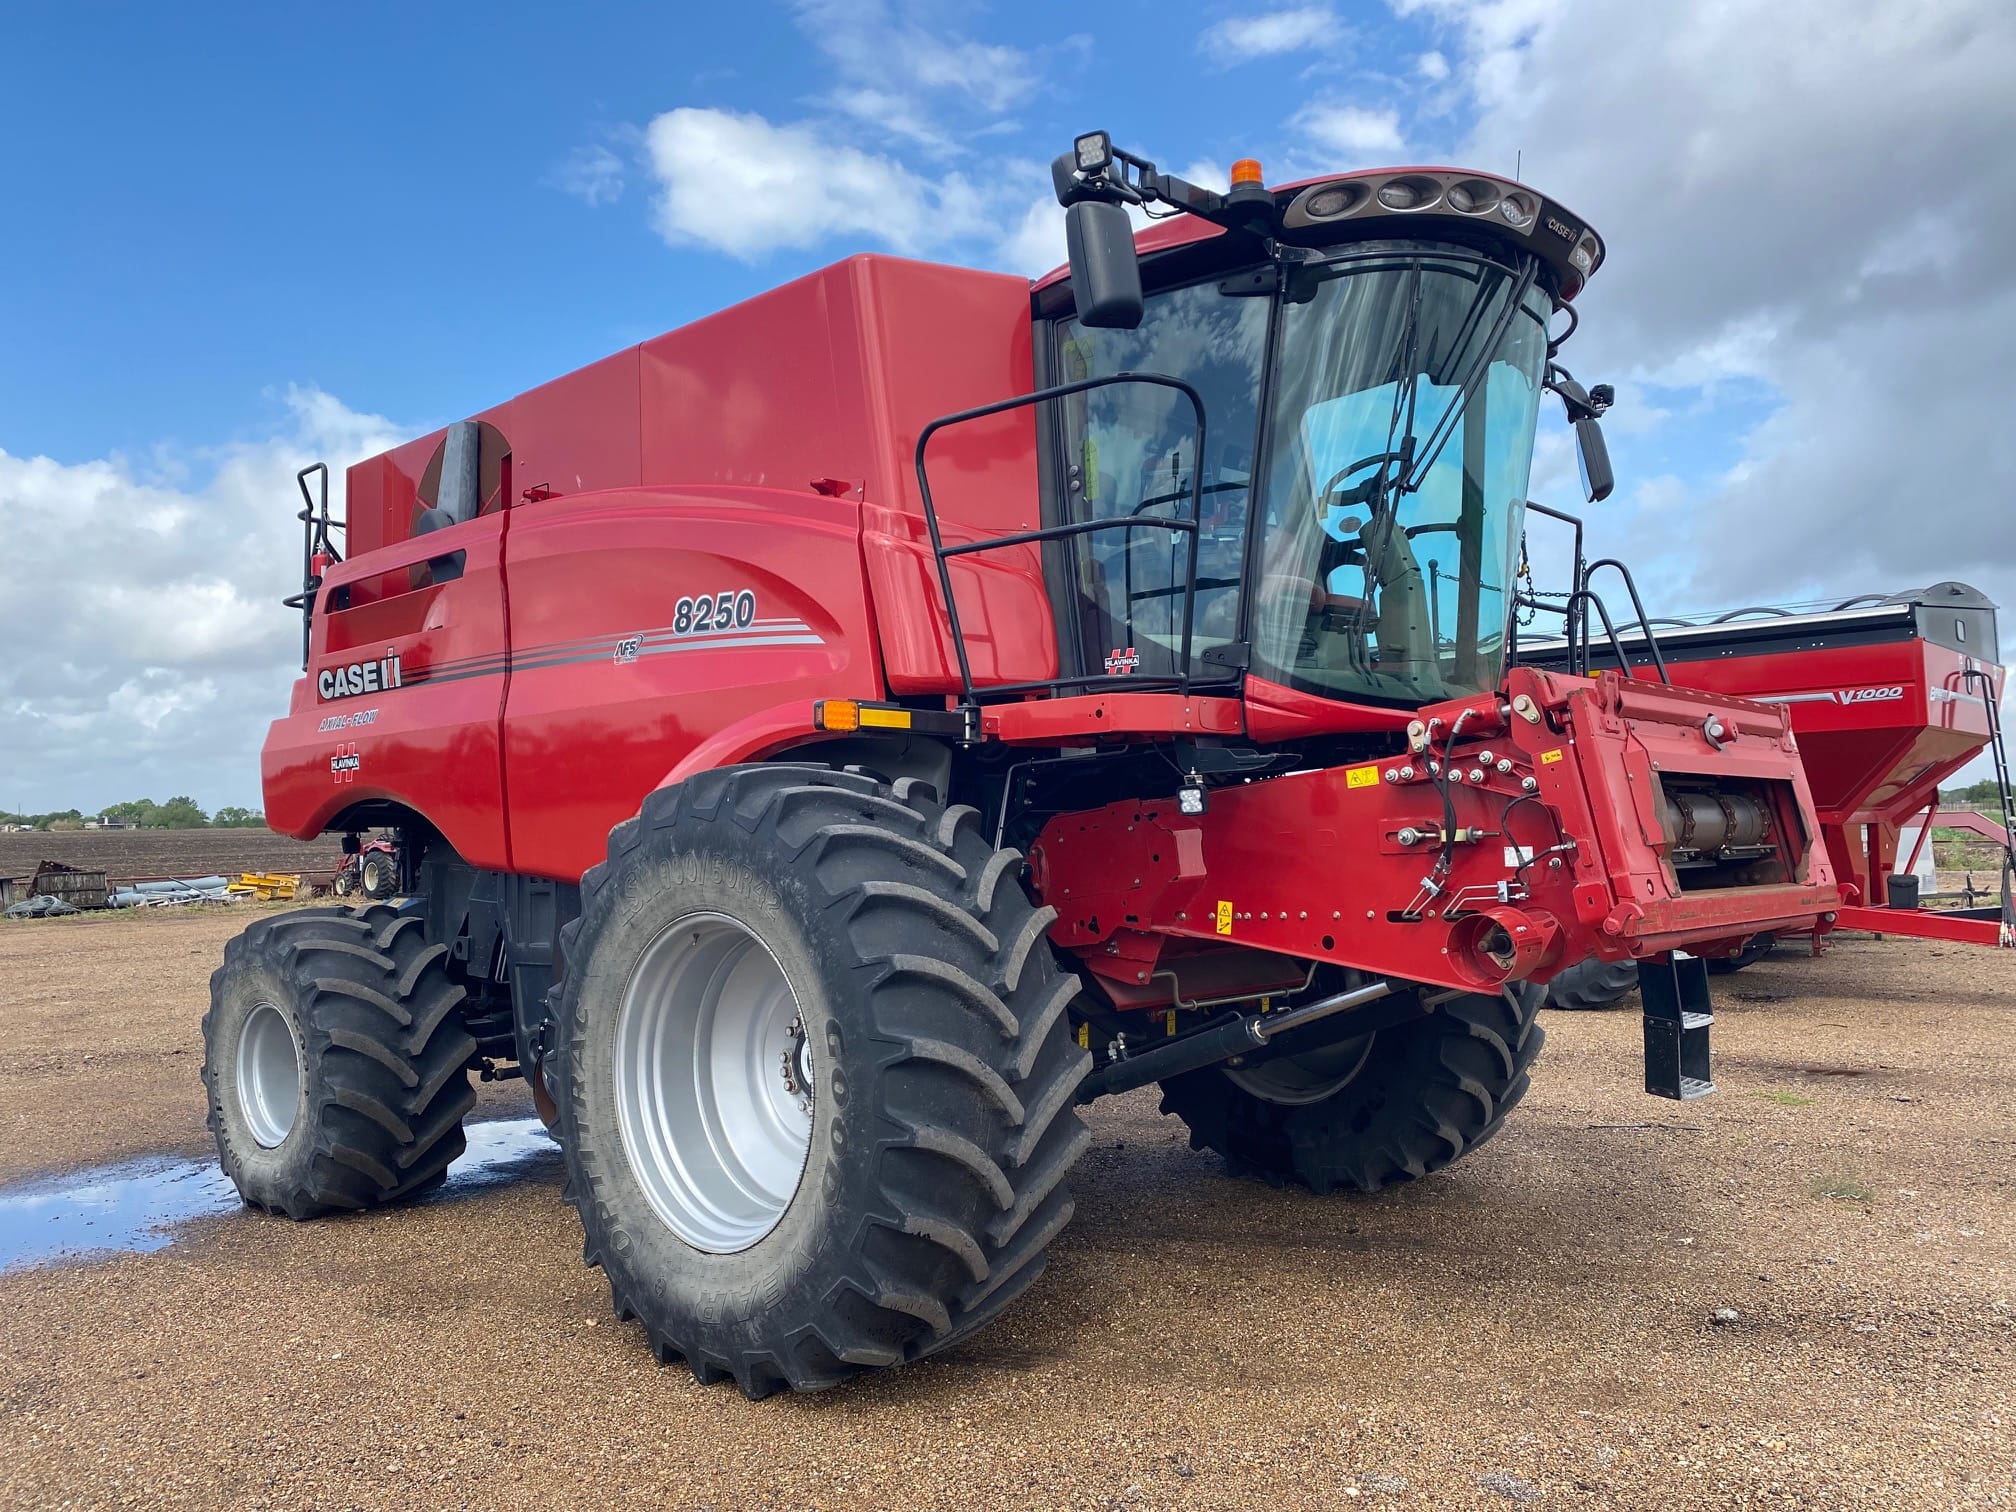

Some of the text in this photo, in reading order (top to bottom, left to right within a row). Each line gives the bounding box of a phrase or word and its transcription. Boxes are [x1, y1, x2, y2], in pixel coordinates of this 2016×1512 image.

[1548, 218, 1569, 238] CASE
[673, 589, 755, 635] 8250
[614, 636, 640, 657] AFS
[1105, 657, 1138, 667] HLAVINKA
[319, 661, 379, 700] CASE
[1839, 687, 1903, 705] V1000
[318, 709, 378, 732] AXIAL-FLOW
